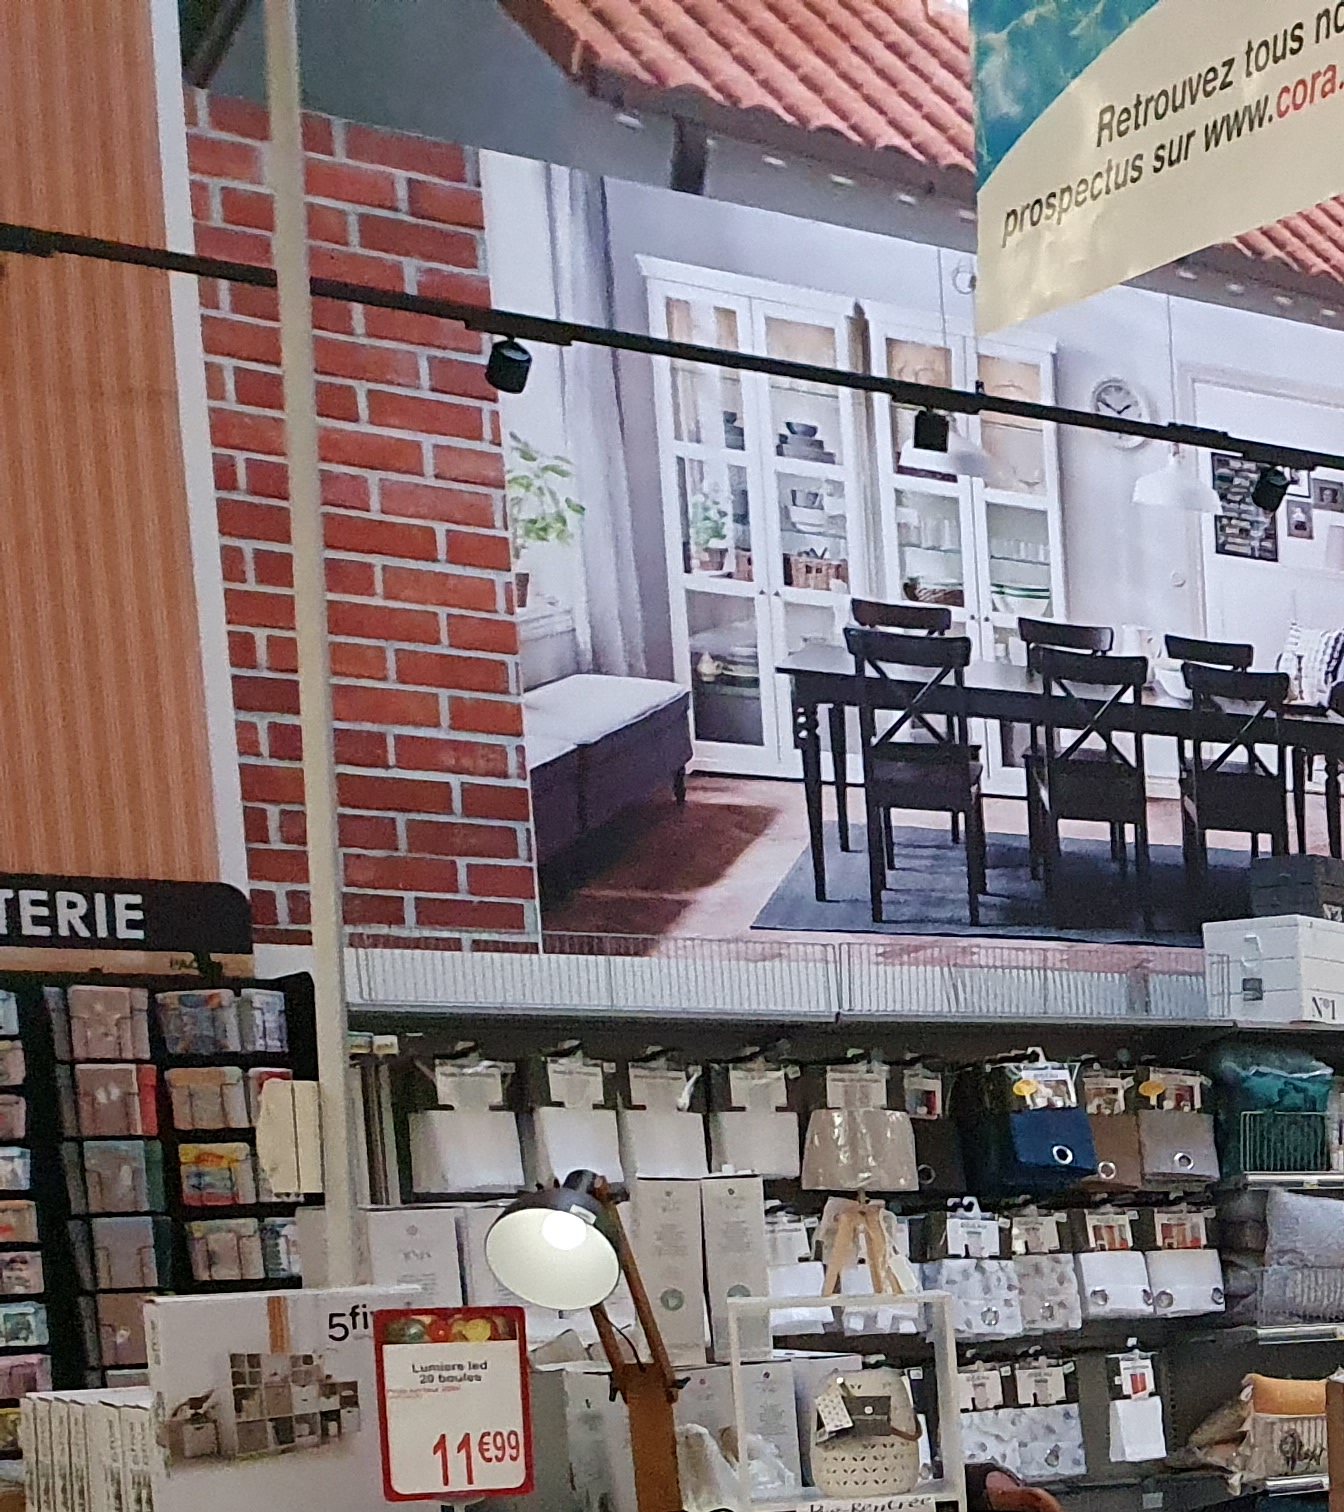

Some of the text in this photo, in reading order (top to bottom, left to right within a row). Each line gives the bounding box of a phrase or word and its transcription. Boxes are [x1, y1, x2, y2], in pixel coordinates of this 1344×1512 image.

[1096, 56, 1235, 147] Retrouvez
[1244, 22, 1304, 78] tous
[1001, 153, 1143, 248] prospectus
[1153, 126, 1196, 174] sur
[328, 1304, 374, 1341] 5fi
